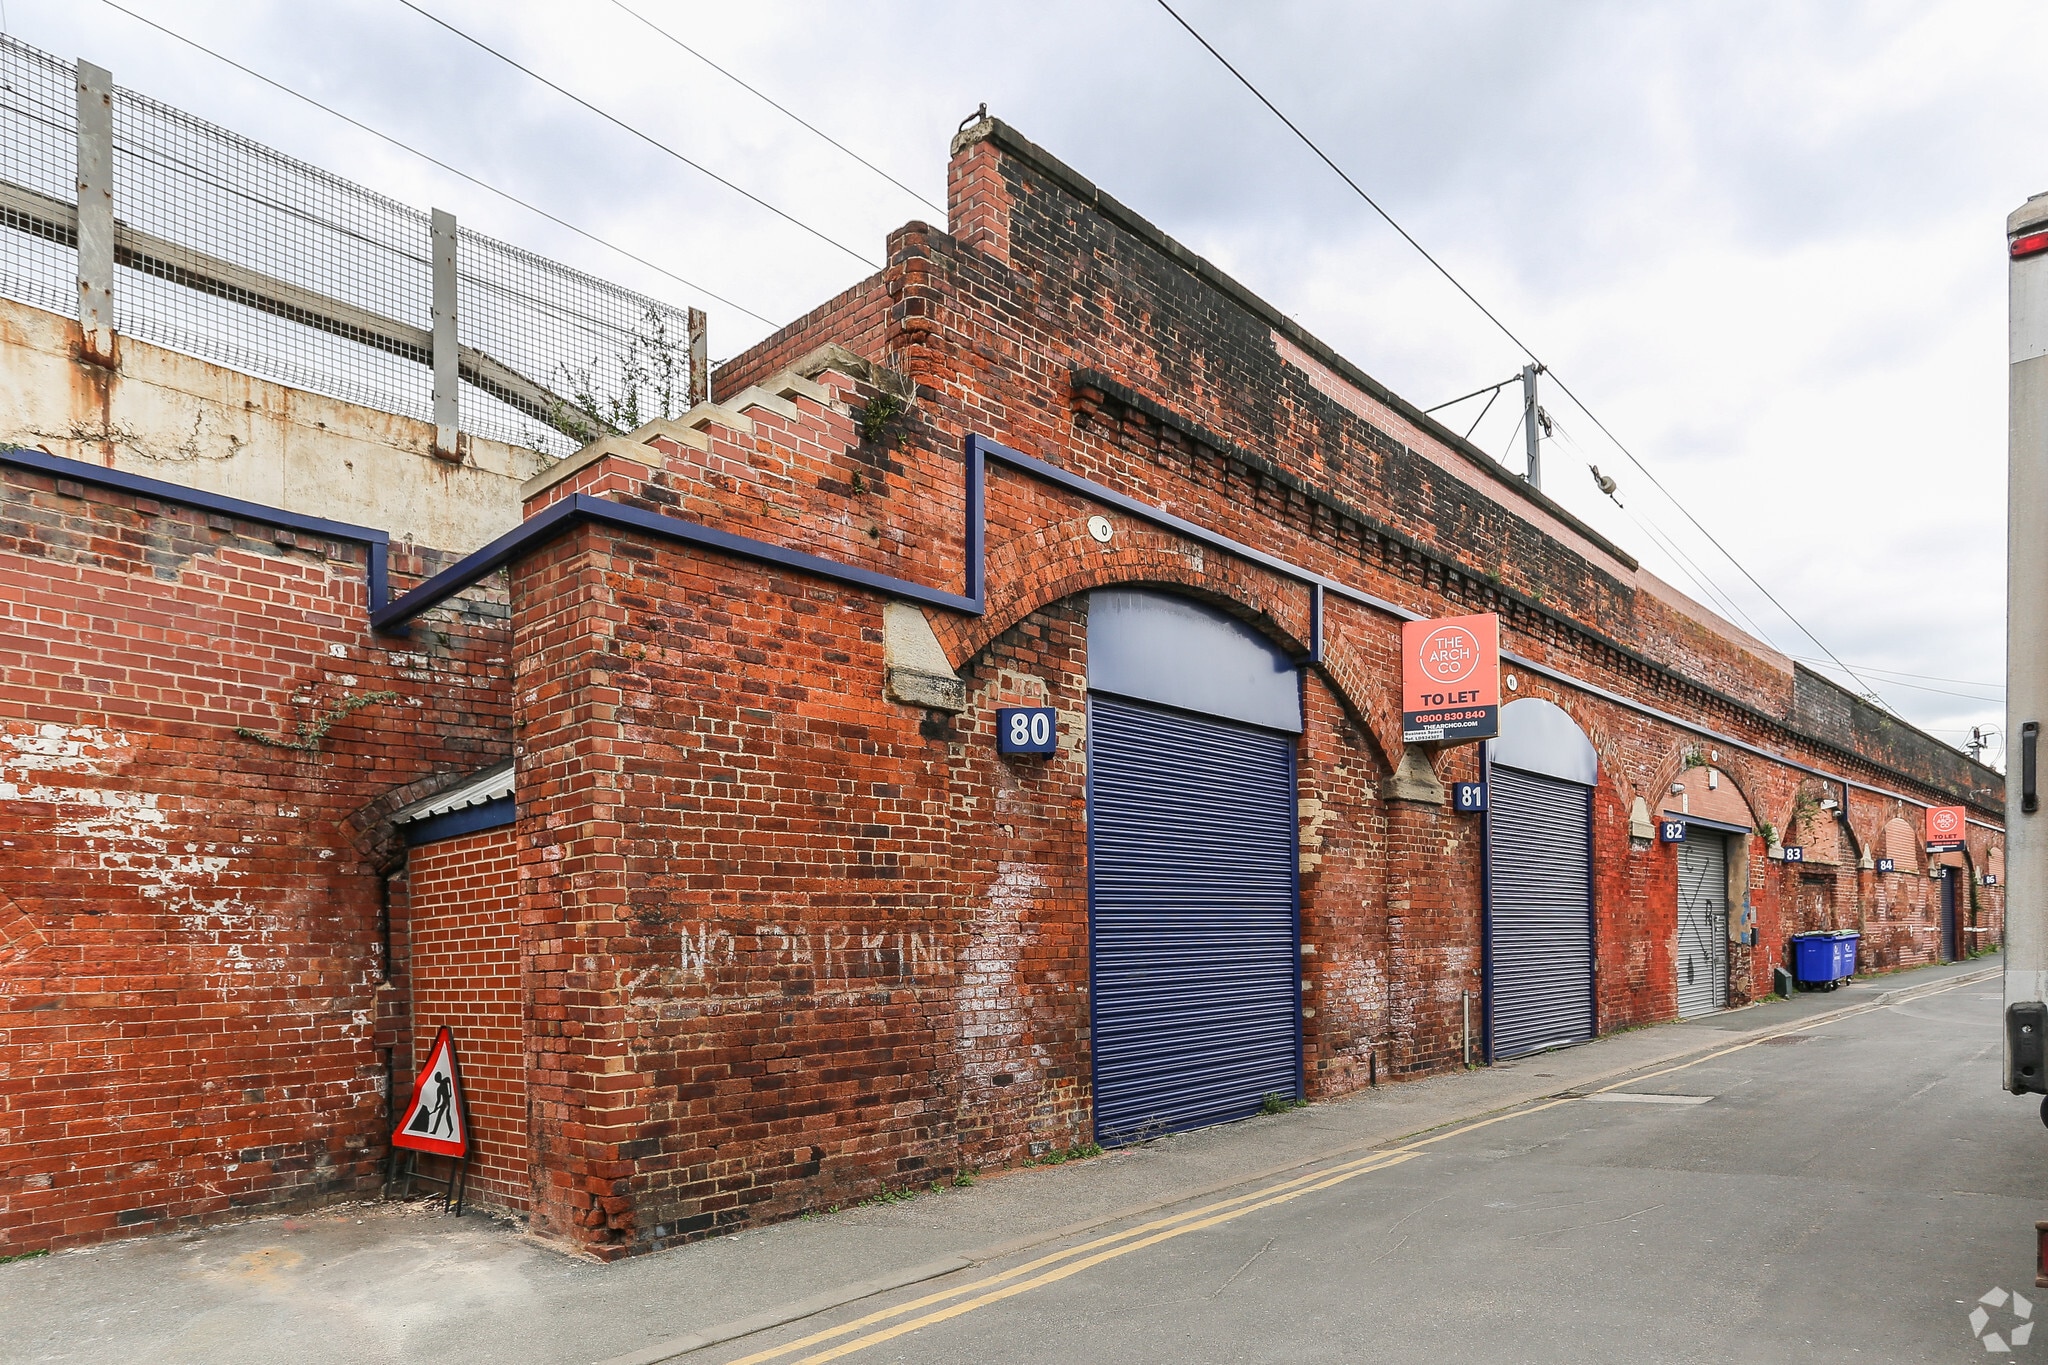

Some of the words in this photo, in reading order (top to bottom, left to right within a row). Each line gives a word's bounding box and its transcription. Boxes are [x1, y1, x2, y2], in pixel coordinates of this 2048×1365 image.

[1434, 636, 1463, 650] THE
[1429, 648, 1470, 662] ARCH
[1438, 661, 1461, 674] CO
[1420, 693, 1444, 706] TO
[1448, 690, 1480, 704] LET
[1415, 714, 1442, 723] 0800
[1444, 712, 1463, 721] 830
[1465, 710, 1486, 719] 840
[1010, 712, 1050, 746] 80
[1423, 721, 1478, 730] THEARCHCO.COM
[1462, 786, 1481, 807] 81
[1666, 823, 1682, 839] 82
[1786, 848, 1801, 860] 83
[1880, 860, 1893, 870] 84
